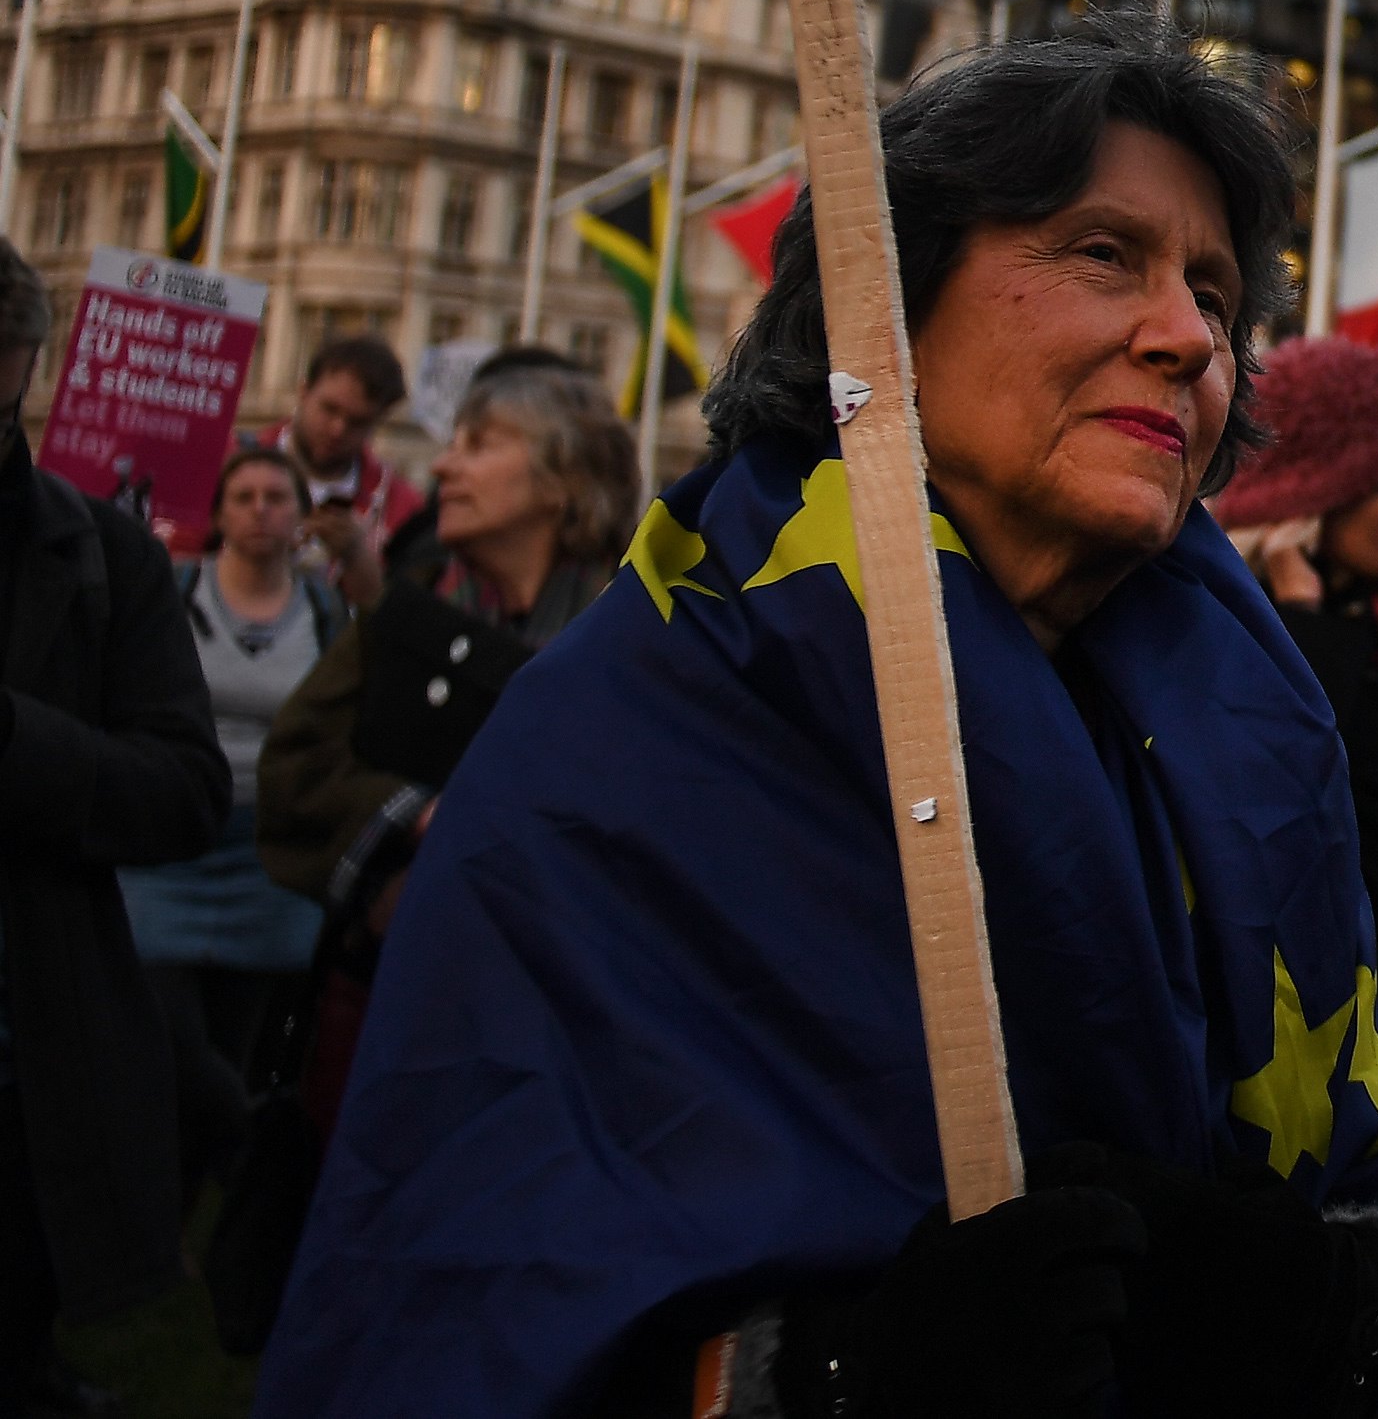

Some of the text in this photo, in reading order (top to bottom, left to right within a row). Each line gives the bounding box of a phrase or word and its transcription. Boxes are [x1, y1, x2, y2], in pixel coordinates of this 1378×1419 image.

[86, 292, 225, 351] Hands off
[77, 324, 239, 387] EU workers
[100, 367, 222, 416] students
